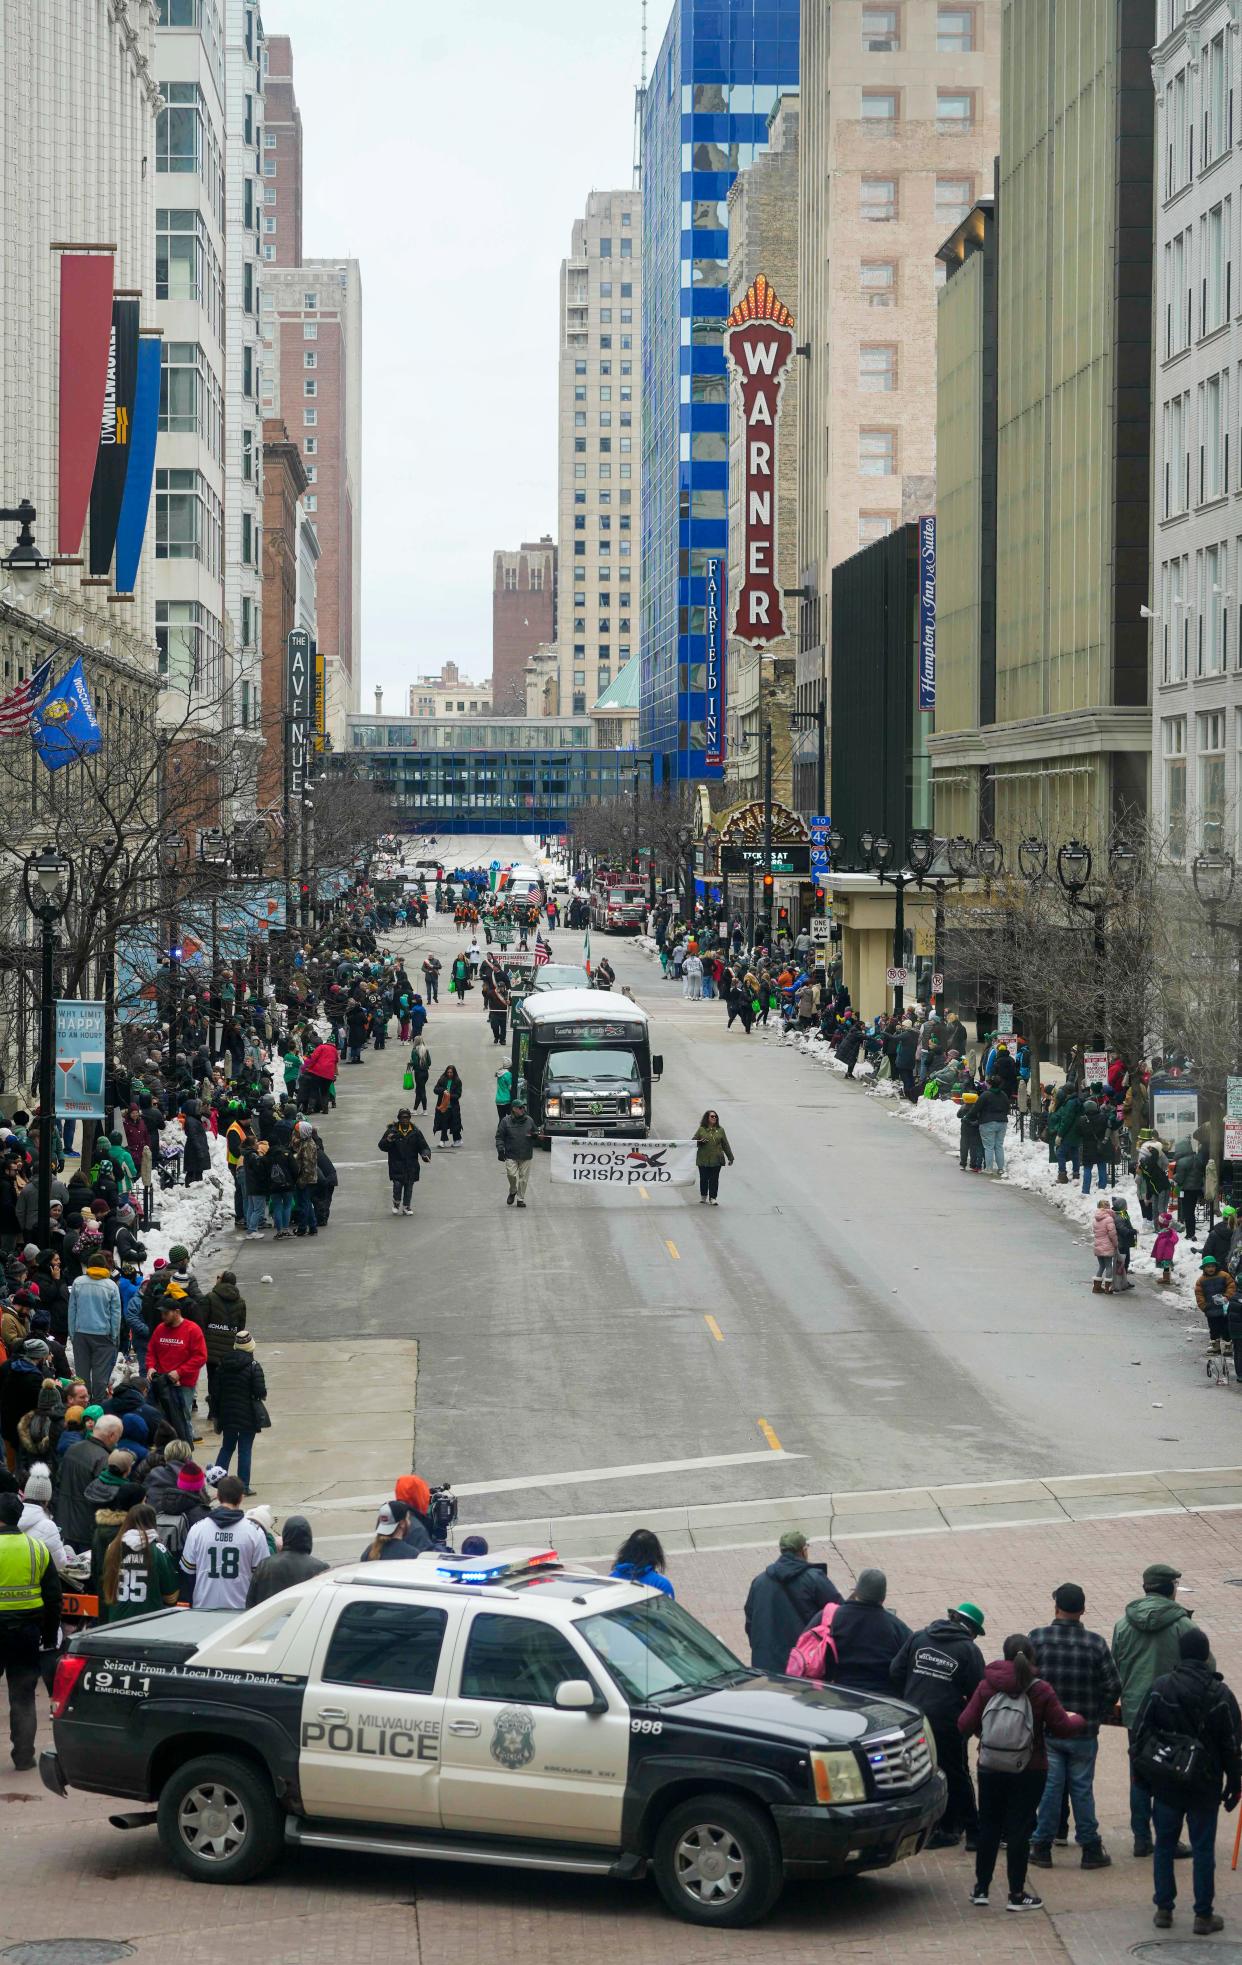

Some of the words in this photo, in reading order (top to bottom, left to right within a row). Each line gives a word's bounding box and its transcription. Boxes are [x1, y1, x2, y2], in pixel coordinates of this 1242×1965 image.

[743, 341, 779, 624] WARNER
[921, 517, 936, 564] Suites
[921, 572, 936, 617] Inn
[707, 559, 718, 690] FAIRFIELD
[292, 636, 306, 646] THE
[921, 617, 936, 703] Hampton
[292, 652, 305, 792] AVENUE
[707, 698, 717, 743] INN
[813, 831, 828, 843] 43
[812, 851, 828, 862] 94
[57, 1018, 101, 1030] HAPPY
[59, 1010, 76, 1018] WHY
[80, 1011, 102, 1019] LIMIT
[57, 1031, 66, 1039] TO
[68, 1031, 78, 1039] AN
[627, 1167, 673, 1186] pub
[214, 1531, 234, 1543] COBB
[207, 1546, 240, 1579] 18
[95, 1672, 150, 1692] 911
[103, 1659, 136, 1672] Seized
[139, 1663, 166, 1676] From
[169, 1666, 178, 1676] A
[182, 1667, 210, 1679] Local
[214, 1671, 241, 1684] Drug
[245, 1674, 280, 1686] Dealer
[94, 1686, 150, 1698] EMERGENCY
[358, 1713, 441, 1734] MILWAUKEE
[630, 1718, 663, 1735] 998
[302, 1721, 439, 1761] POLICE
